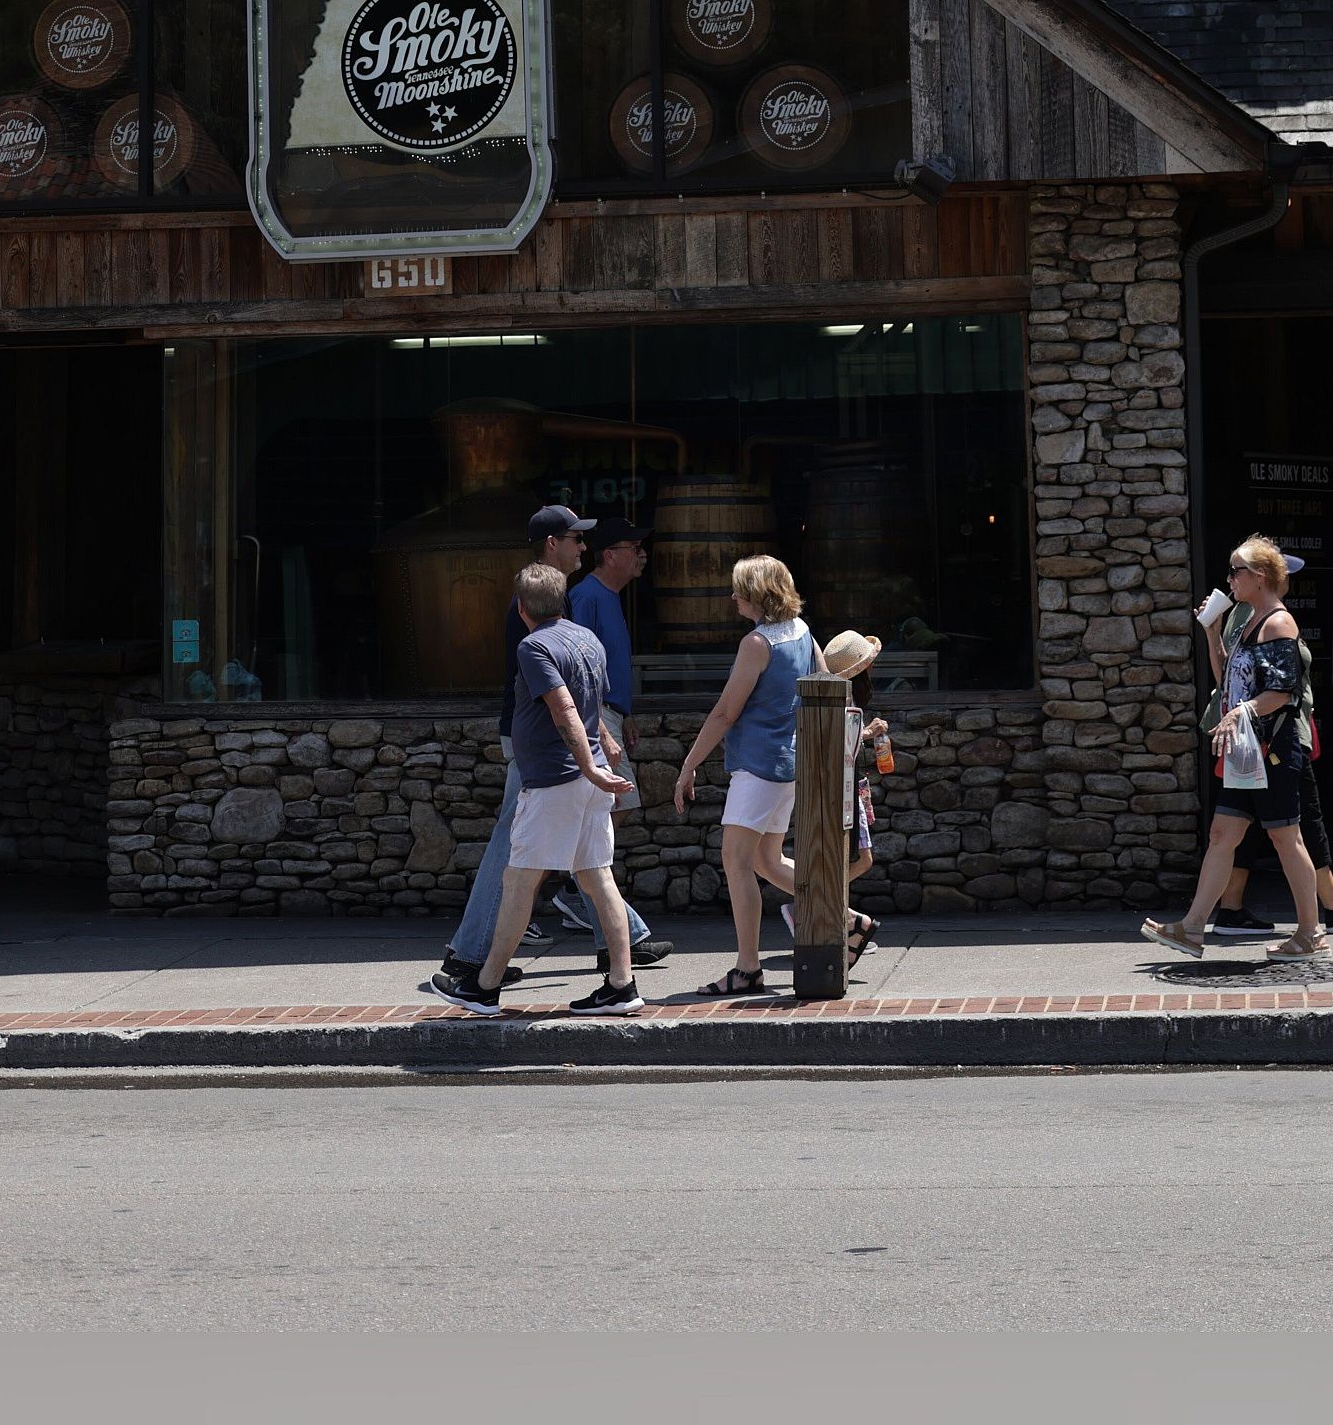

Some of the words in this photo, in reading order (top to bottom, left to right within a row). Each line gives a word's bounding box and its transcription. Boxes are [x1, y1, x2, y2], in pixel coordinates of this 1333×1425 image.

[73, 15, 93, 26] Ole
[408, 2, 459, 33] Ole
[698, 19, 743, 35] Whiskey
[50, 18, 112, 44] Smoky
[59, 44, 102, 59] Whiskey
[353, 8, 506, 81] Smoky
[405, 66, 455, 84] Tennessee
[374, 67, 504, 110] Moonshine
[787, 90, 808, 103] Ole
[629, 102, 694, 127] Soky
[763, 95, 828, 120] Smoky
[7, 118, 26, 131] Ole
[112, 120, 174, 146] Smky
[637, 127, 684, 144] Wkey
[771, 120, 818, 137] Whiskey
[371, 257, 445, 289] 650
[1250, 462, 1266, 480] OLE
[1268, 463, 1299, 482] SMOKY
[1301, 465, 1329, 484] DEALS
